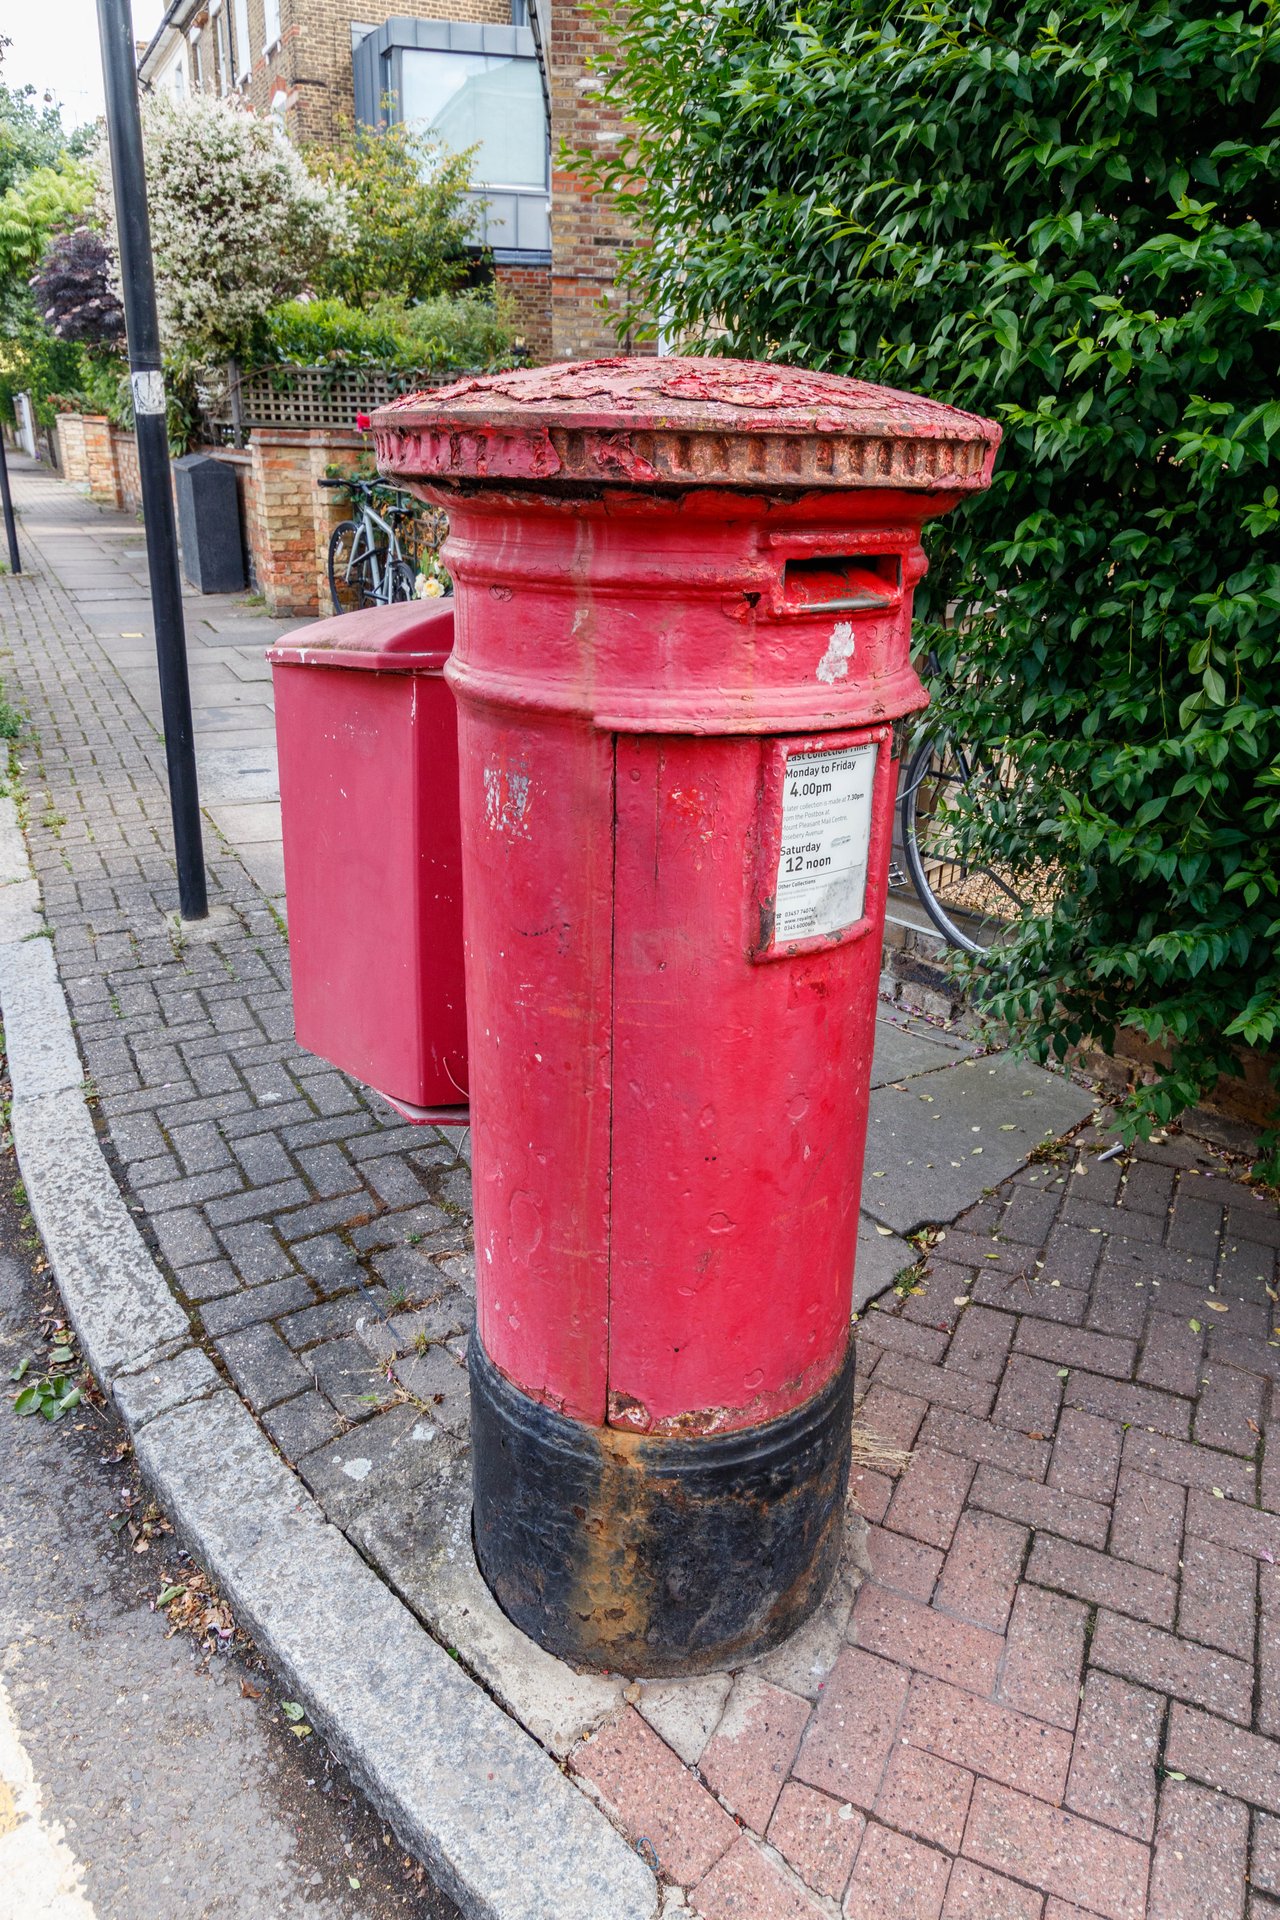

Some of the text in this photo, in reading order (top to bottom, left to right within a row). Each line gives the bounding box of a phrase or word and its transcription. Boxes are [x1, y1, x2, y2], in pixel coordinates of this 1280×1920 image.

[785, 760, 857, 779] Monday to Friday
[790, 781, 832, 798] 4.00pm
[800, 801, 823, 810] collection
[847, 793, 864, 801] 7.30pm
[804, 810, 825, 818] Postbox
[799, 819, 821, 829] Pleasant
[783, 832, 804, 841] osebery
[780, 842, 821, 856] Saturday
[785, 856, 831, 873] 12 noon
[778, 882, 791, 890] Other
[791, 879, 816, 888] Collections
